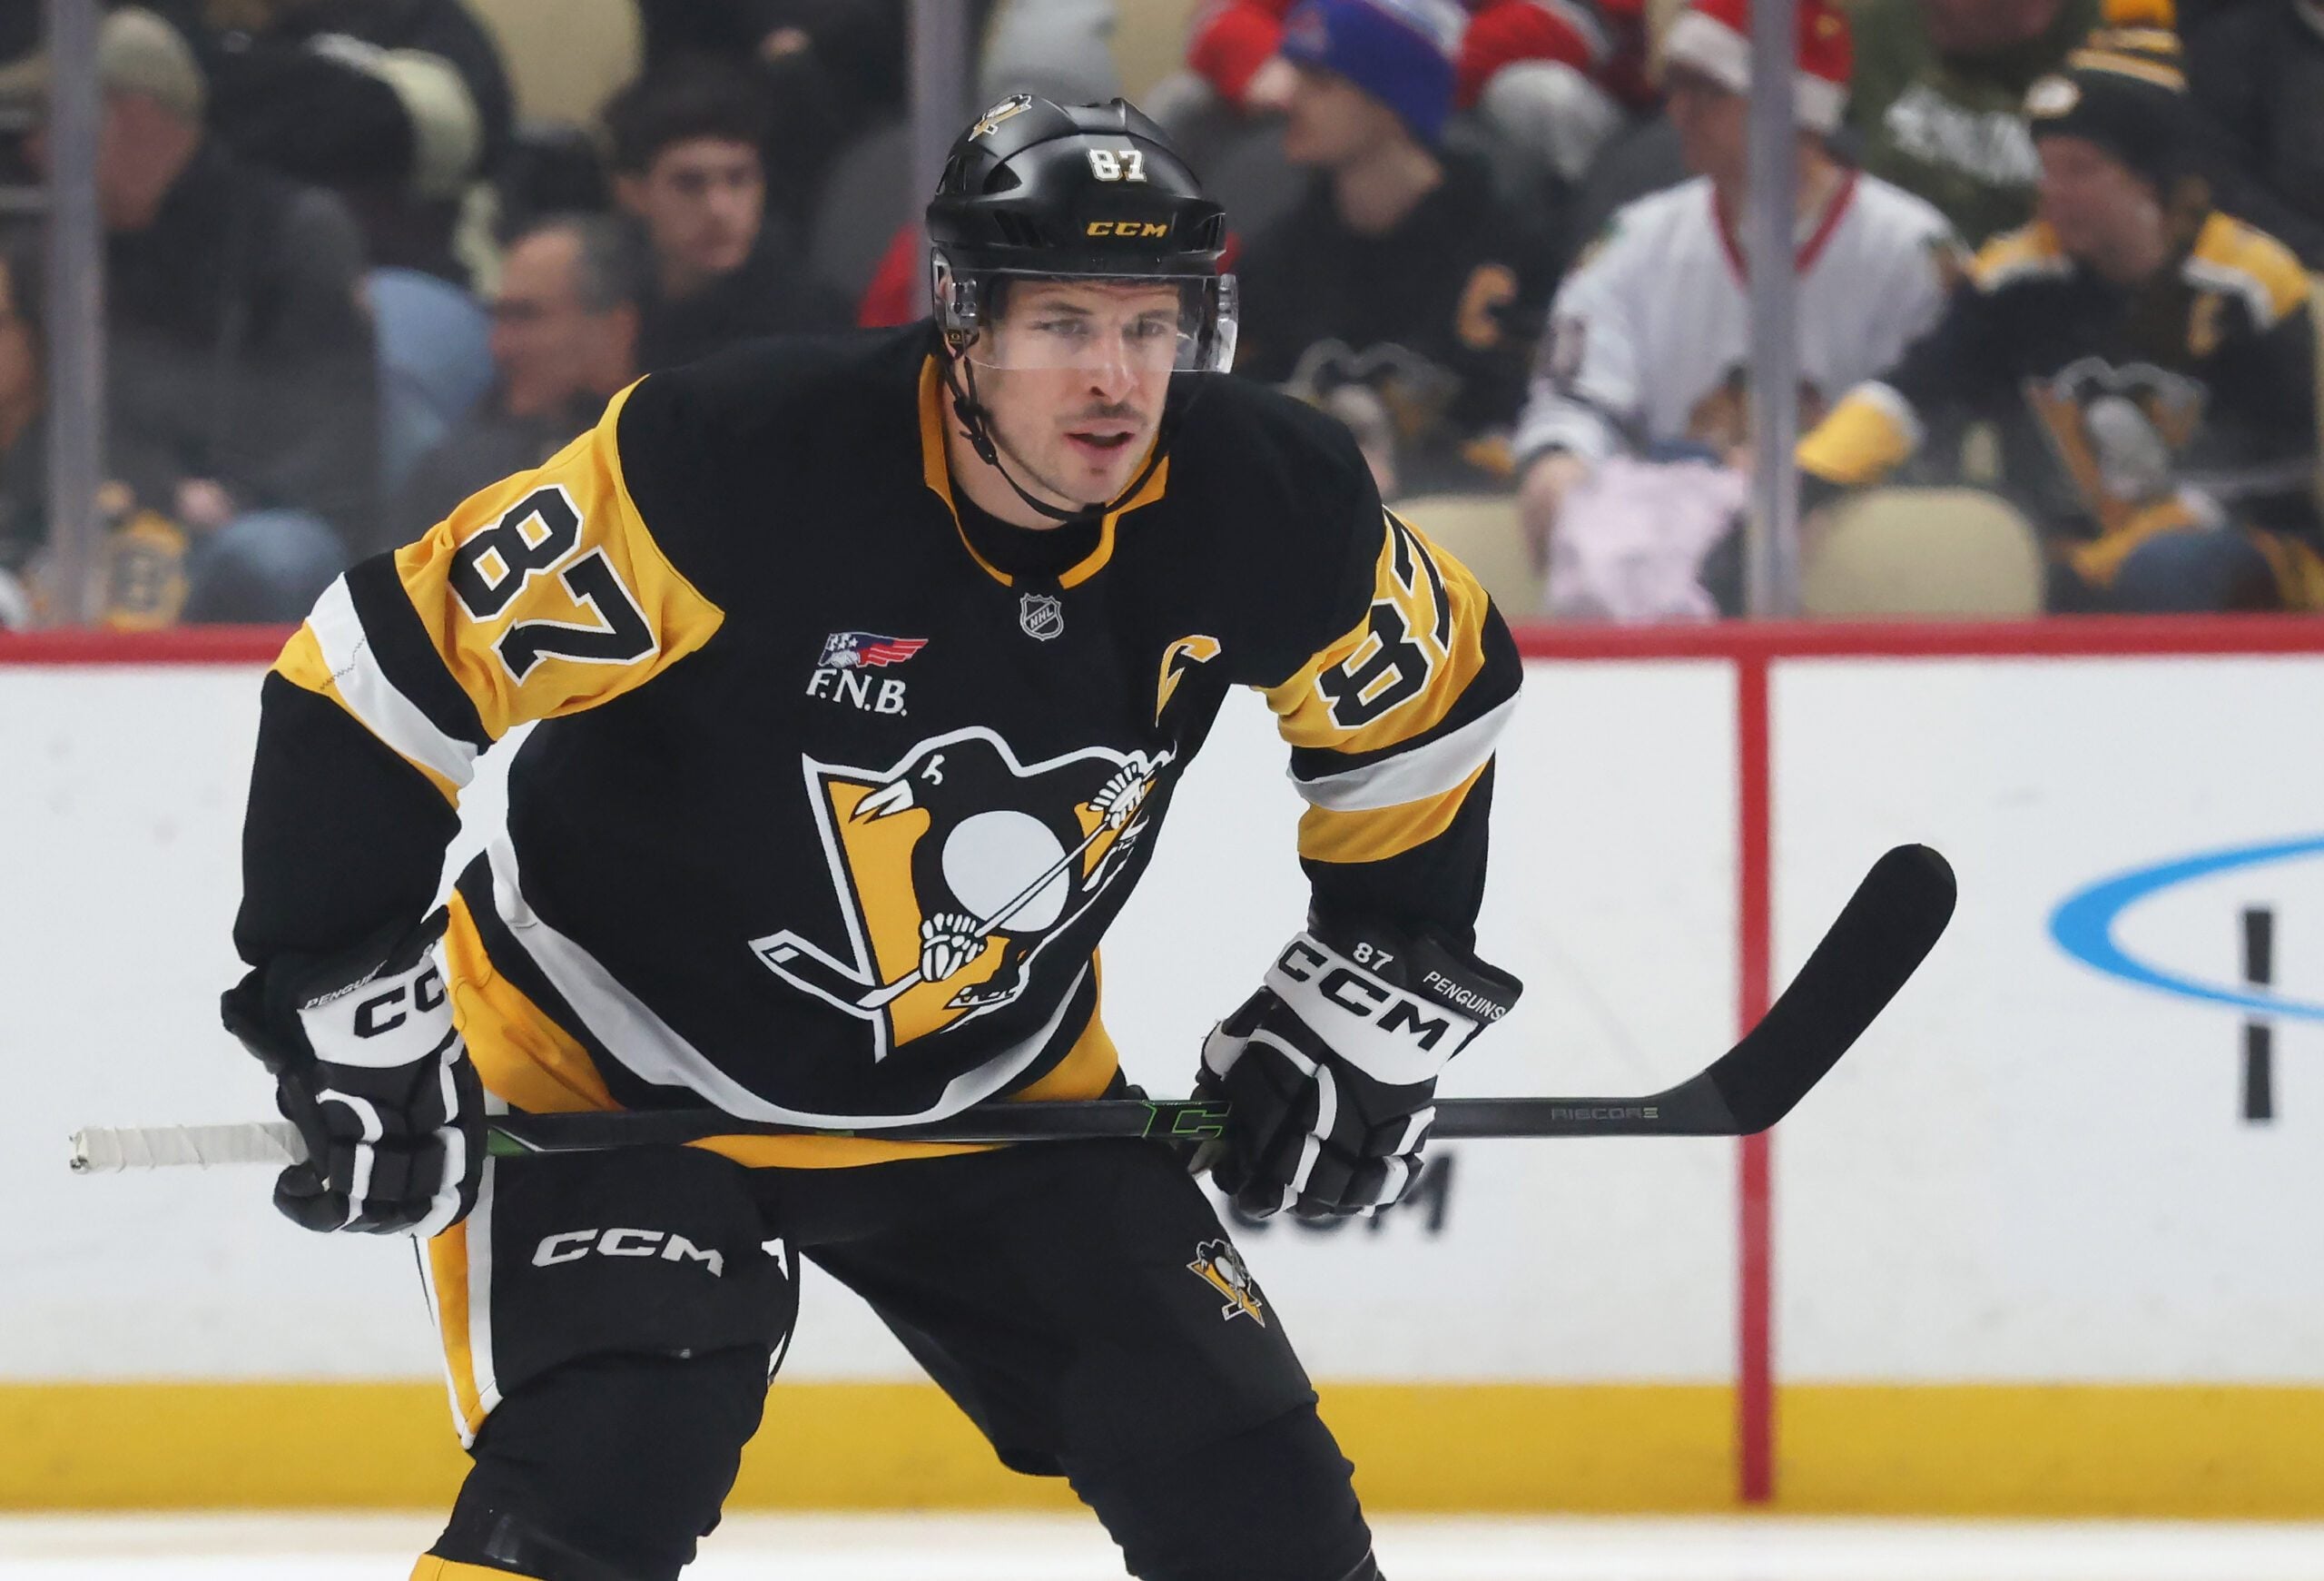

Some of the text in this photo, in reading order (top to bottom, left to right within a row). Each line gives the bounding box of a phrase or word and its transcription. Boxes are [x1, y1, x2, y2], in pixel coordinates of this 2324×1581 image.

[1088, 149, 1147, 182] 87
[1087, 222, 1167, 237] CCM
[448, 484, 661, 687] 87
[1030, 608, 1054, 628] NHL
[1315, 504, 1452, 729] 87
[806, 668, 907, 716] F.N.B.
[1354, 943, 1393, 971] 87
[354, 965, 446, 1038] CC
[1278, 941, 1450, 1051] CCM
[1423, 971, 1505, 1021] PENGUINS
[531, 1228, 724, 1278] CCM
